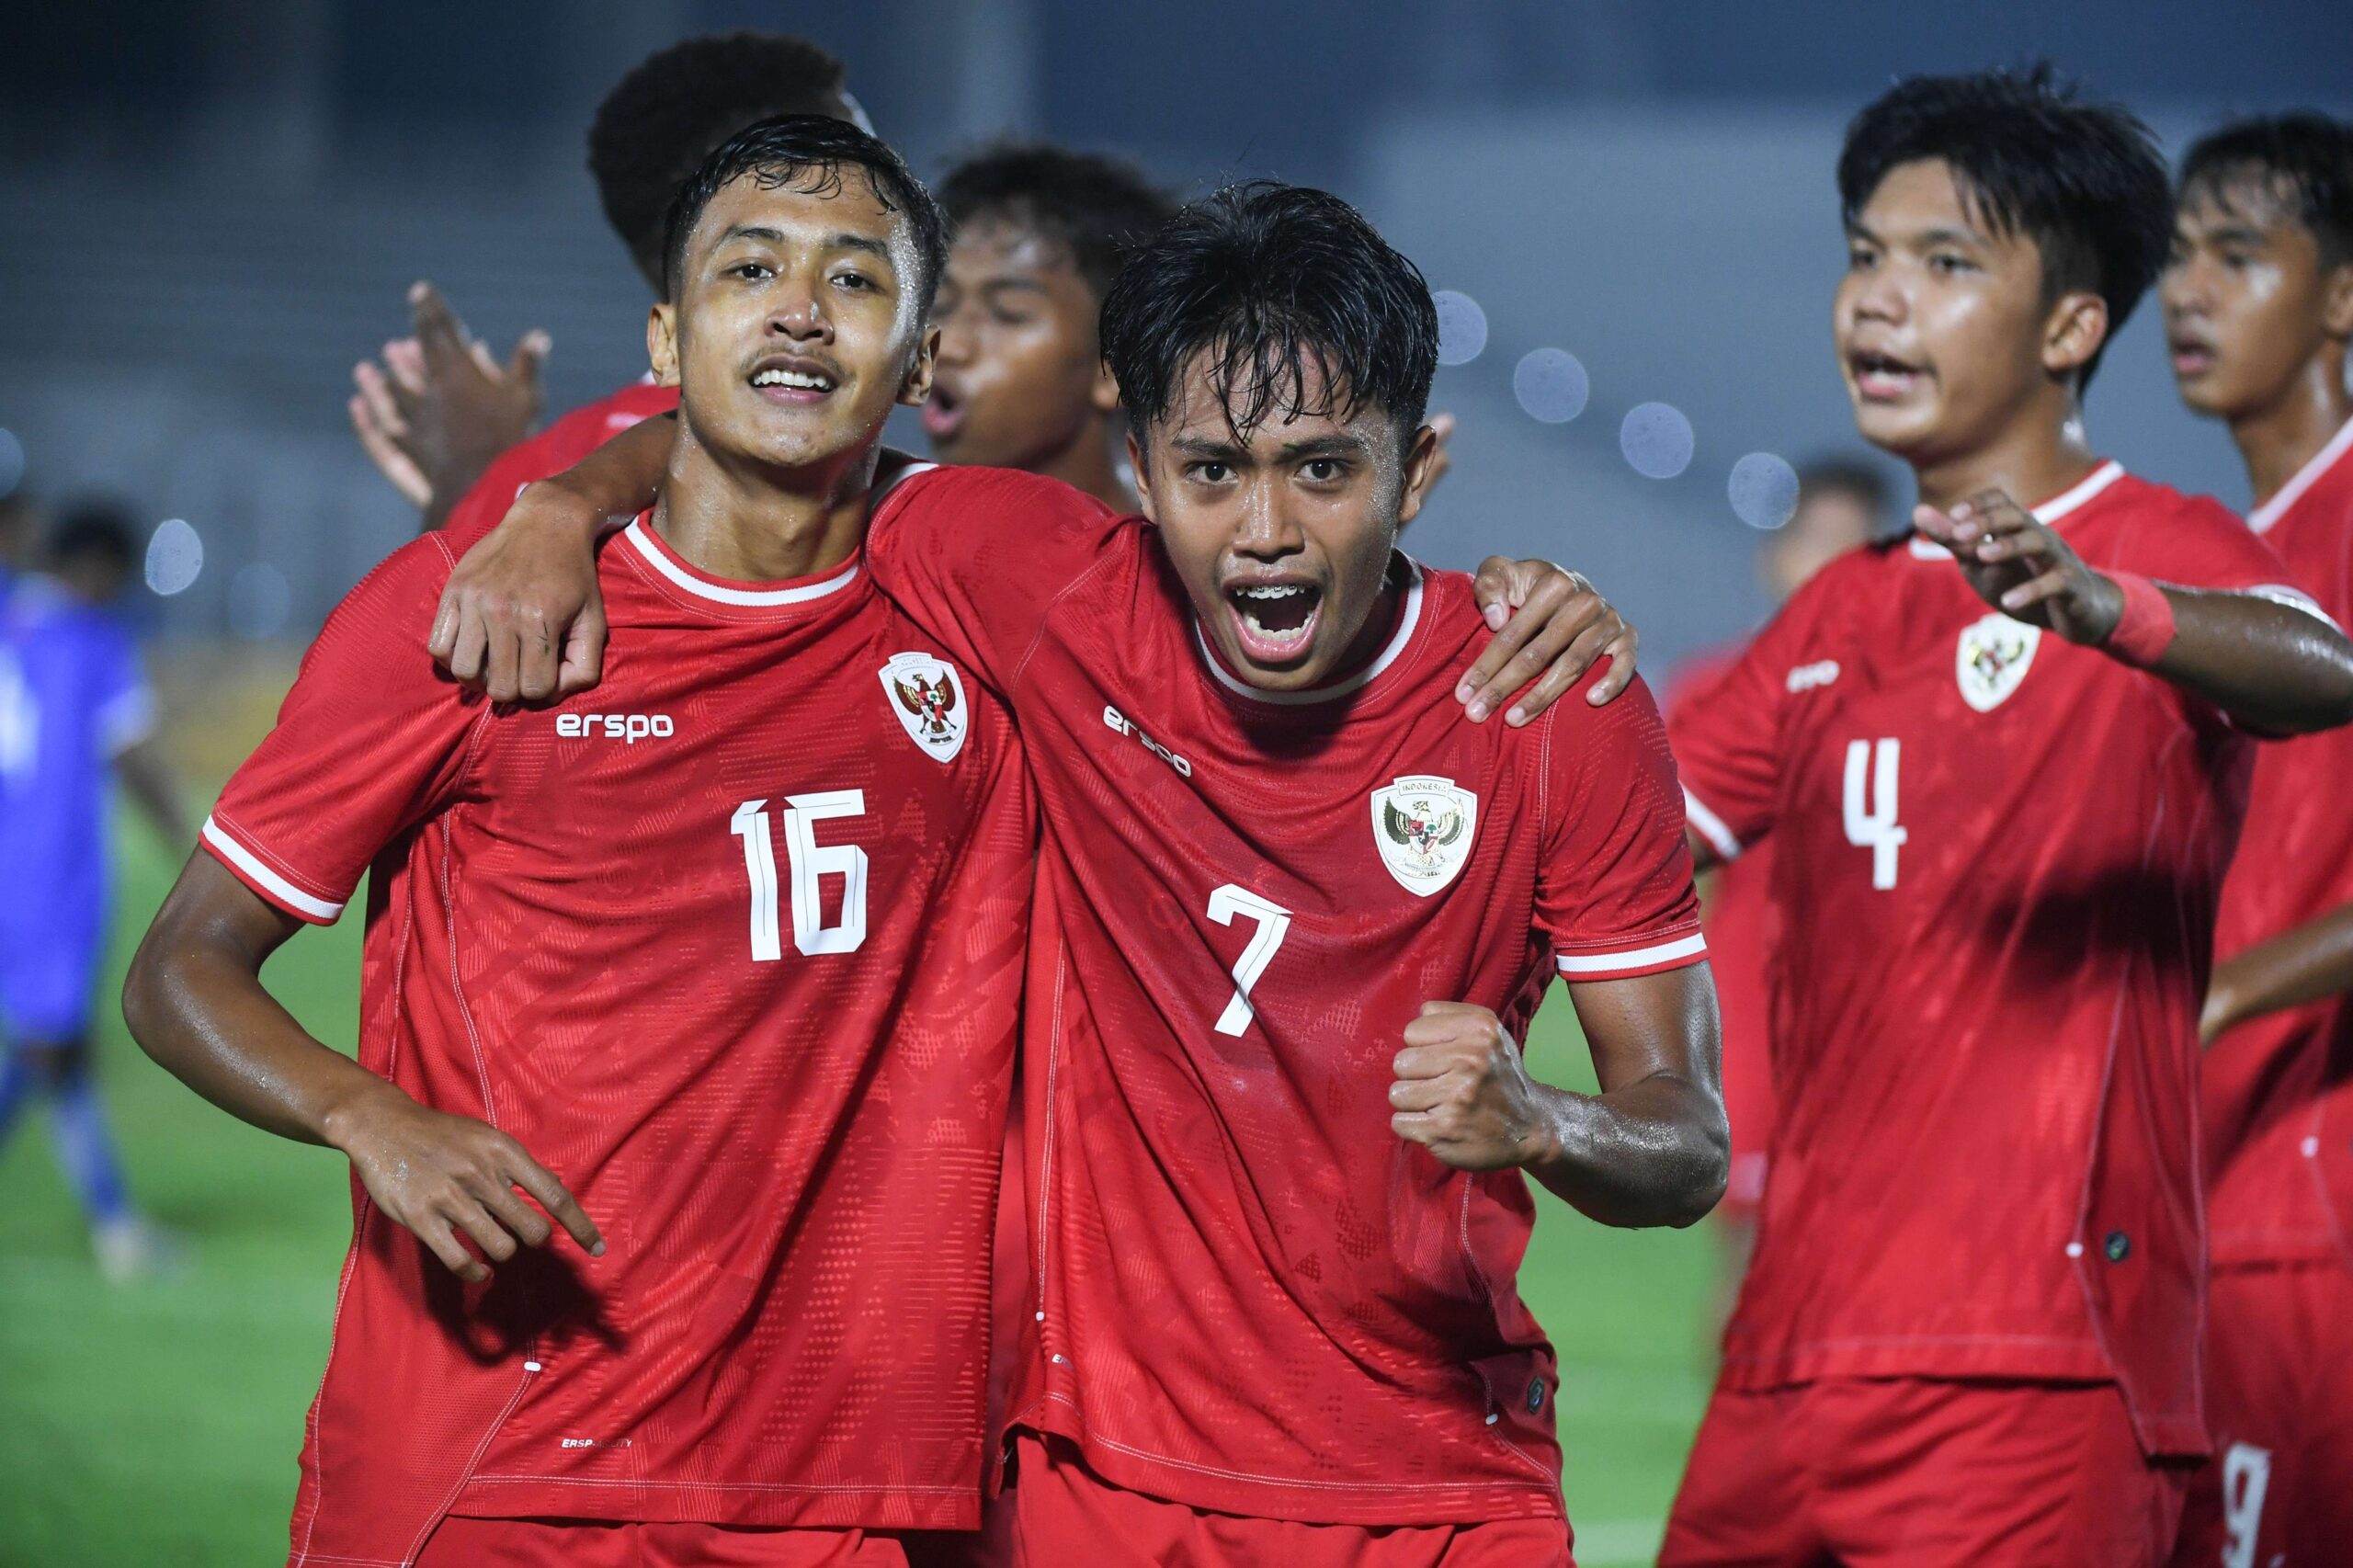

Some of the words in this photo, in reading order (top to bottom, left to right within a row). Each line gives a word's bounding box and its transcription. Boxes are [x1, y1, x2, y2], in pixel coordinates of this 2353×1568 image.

[556, 713, 674, 744] erspo
[730, 789, 869, 961] 16
[1843, 737, 1907, 890] 4
[1206, 882, 1294, 1037] 7
[2221, 1441, 2272, 1568] 9
